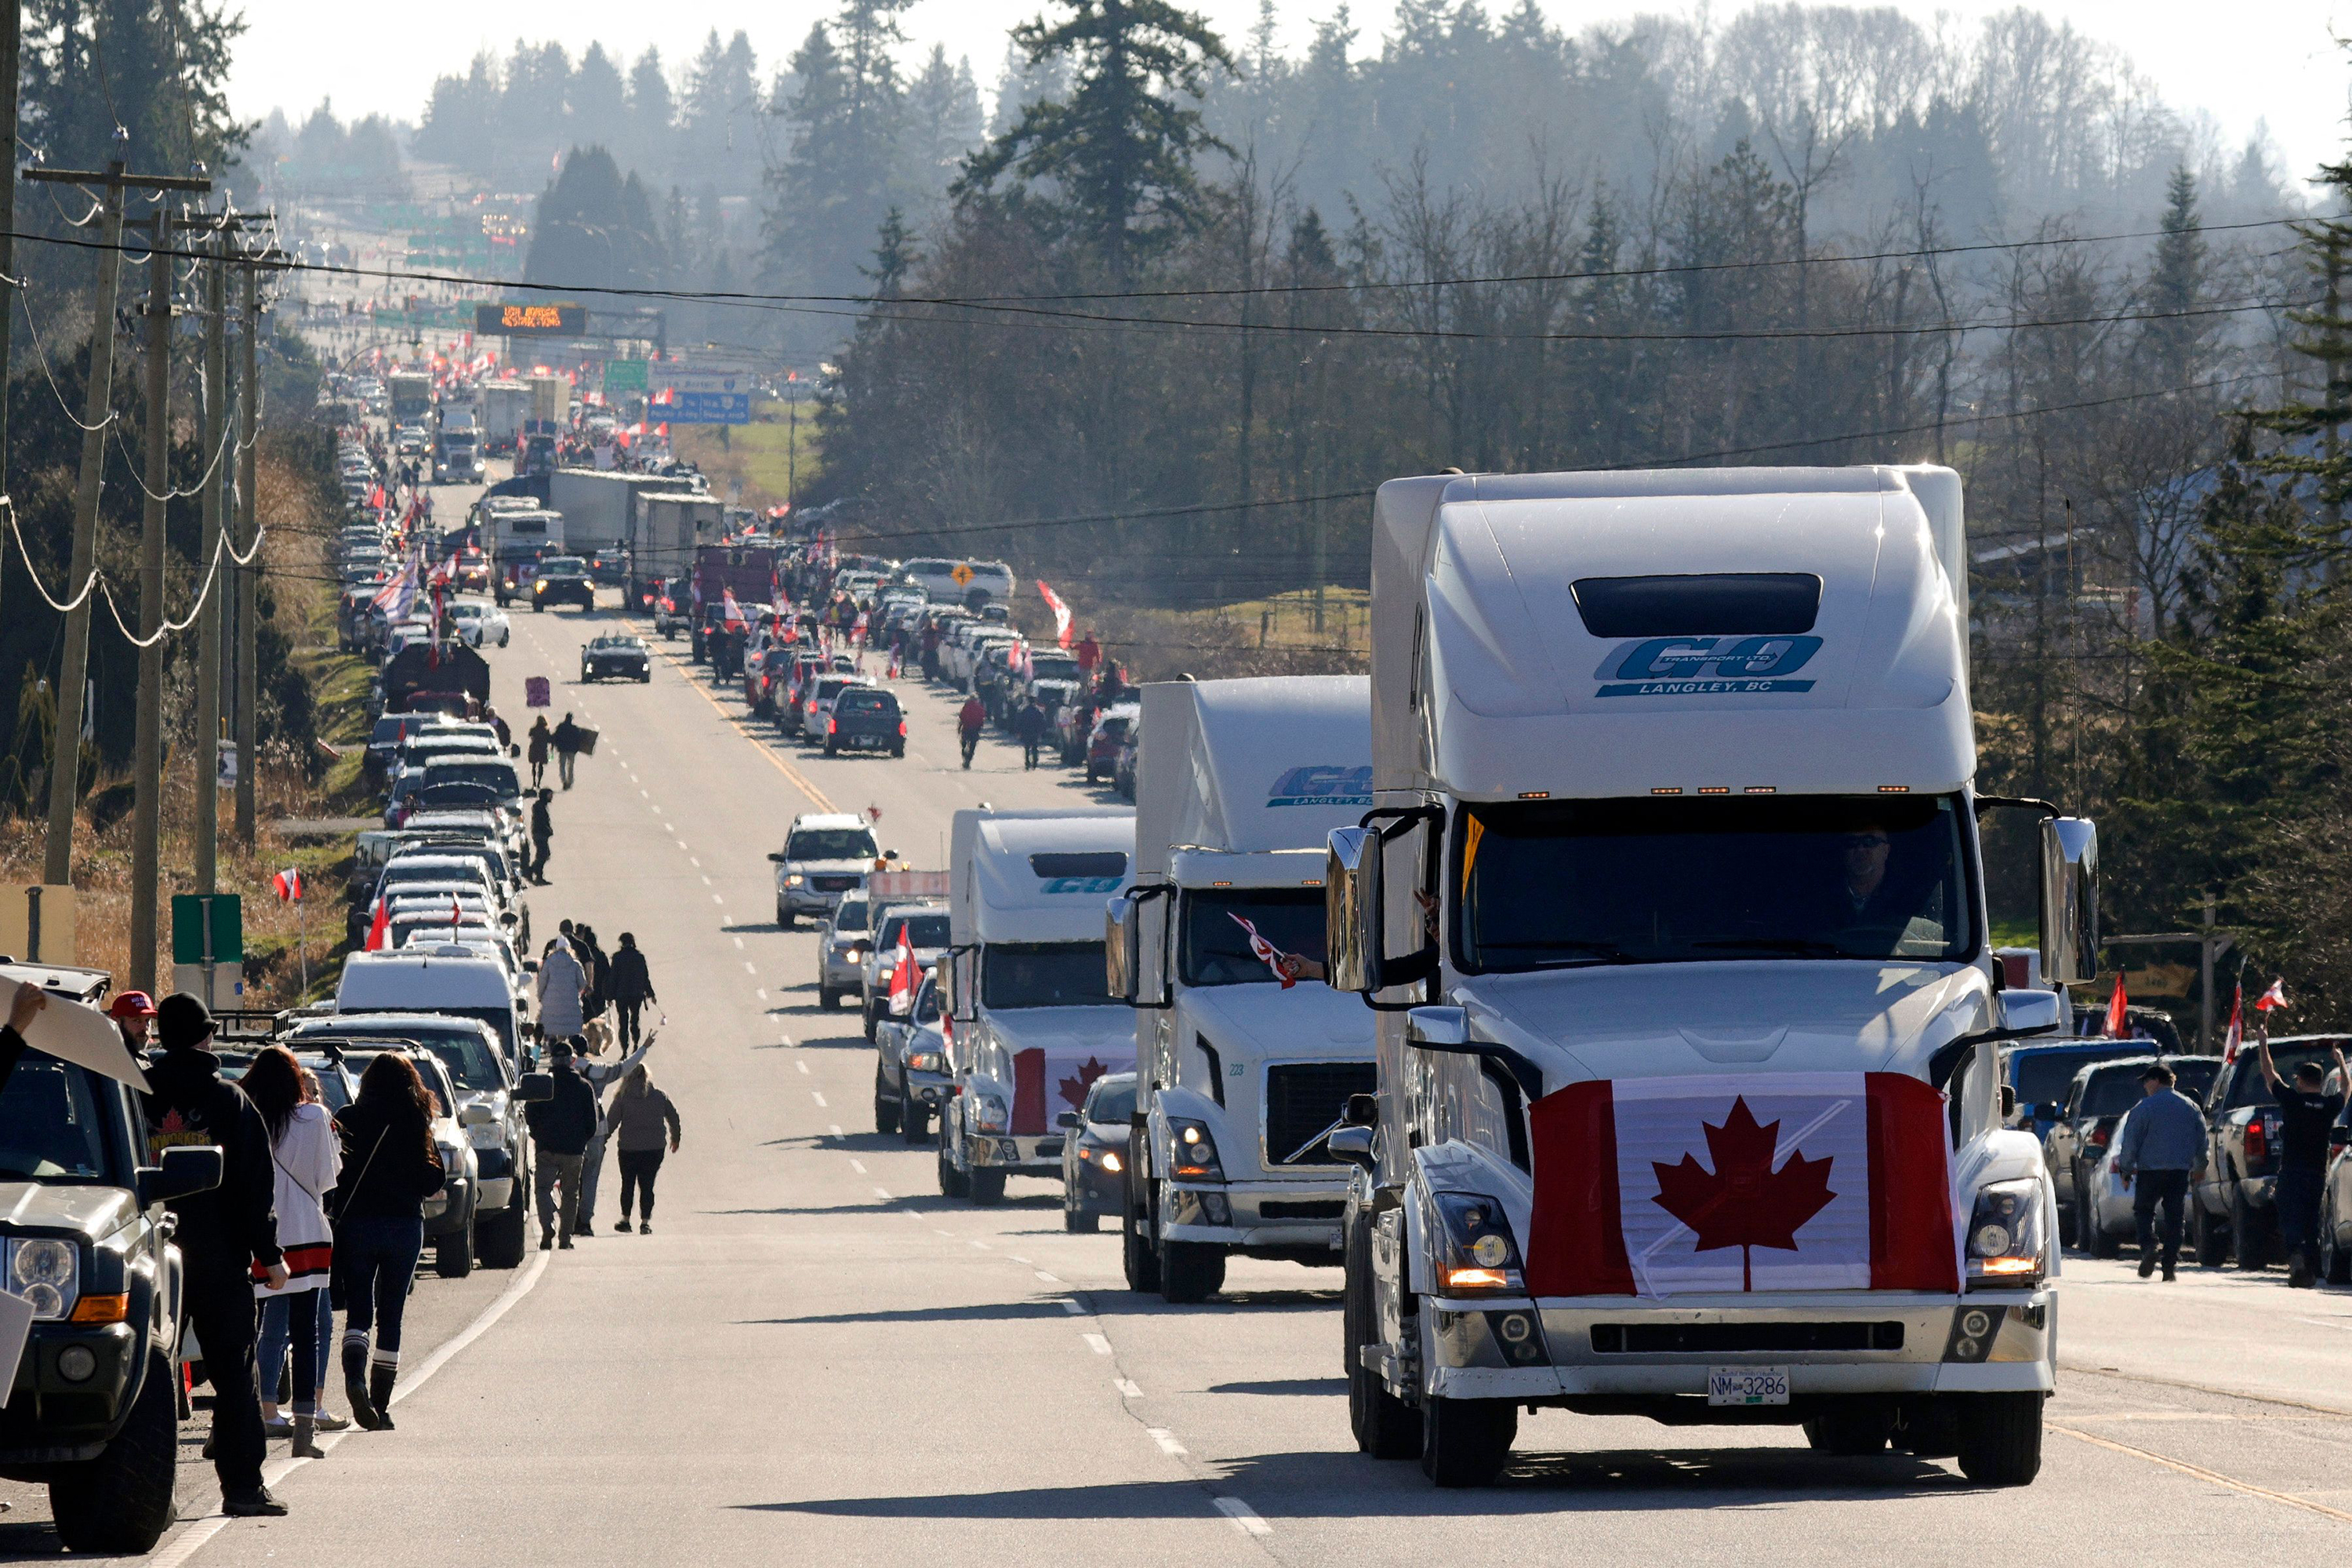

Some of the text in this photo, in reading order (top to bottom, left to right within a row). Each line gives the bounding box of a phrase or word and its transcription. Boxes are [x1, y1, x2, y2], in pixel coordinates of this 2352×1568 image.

[1611, 635, 1824, 680] GO
[1639, 681, 1773, 695] LANGLEY, BC
[1046, 877, 1124, 894] GO
[1229, 1063, 1244, 1076] 223
[1744, 1377, 1787, 1396] 3286
